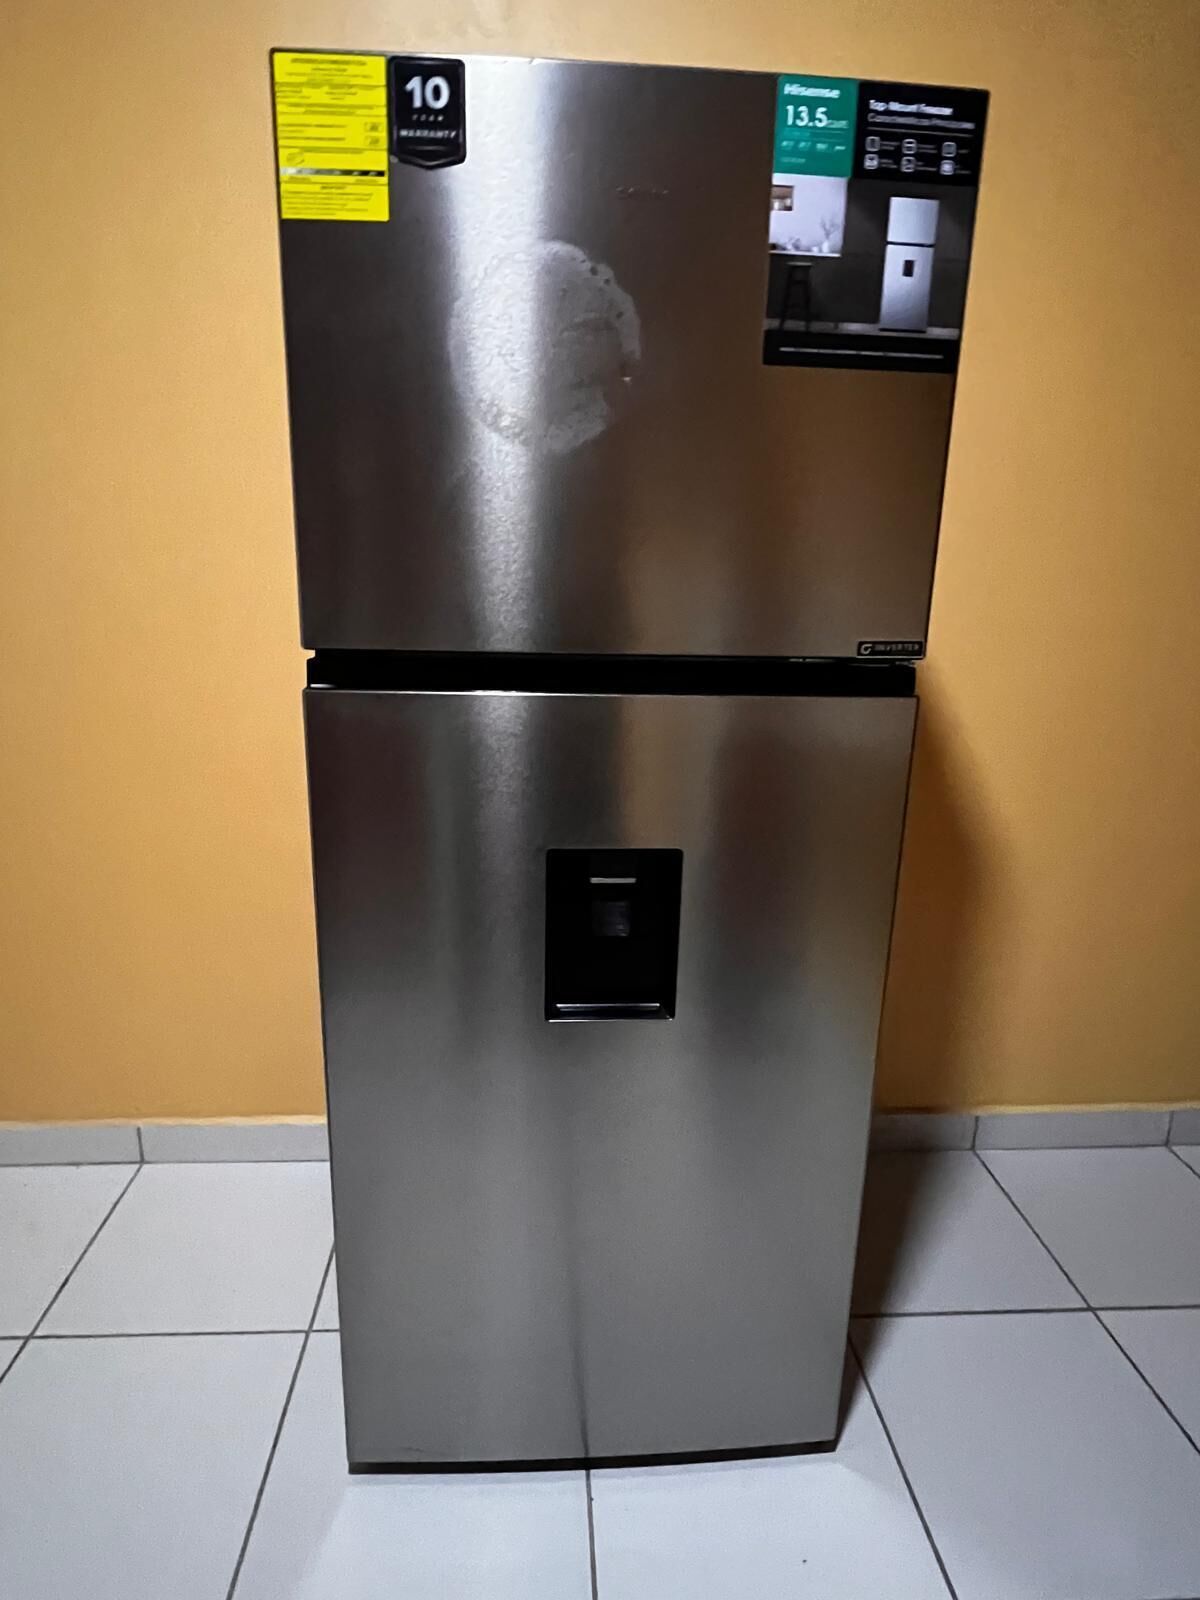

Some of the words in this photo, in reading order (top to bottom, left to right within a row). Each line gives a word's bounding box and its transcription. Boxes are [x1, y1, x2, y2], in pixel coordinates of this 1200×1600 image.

[404, 75, 449, 109] 10
[784, 83, 841, 98] Hisense
[786, 105, 828, 127] 13.5
[399, 129, 457, 138] WARRANTY
